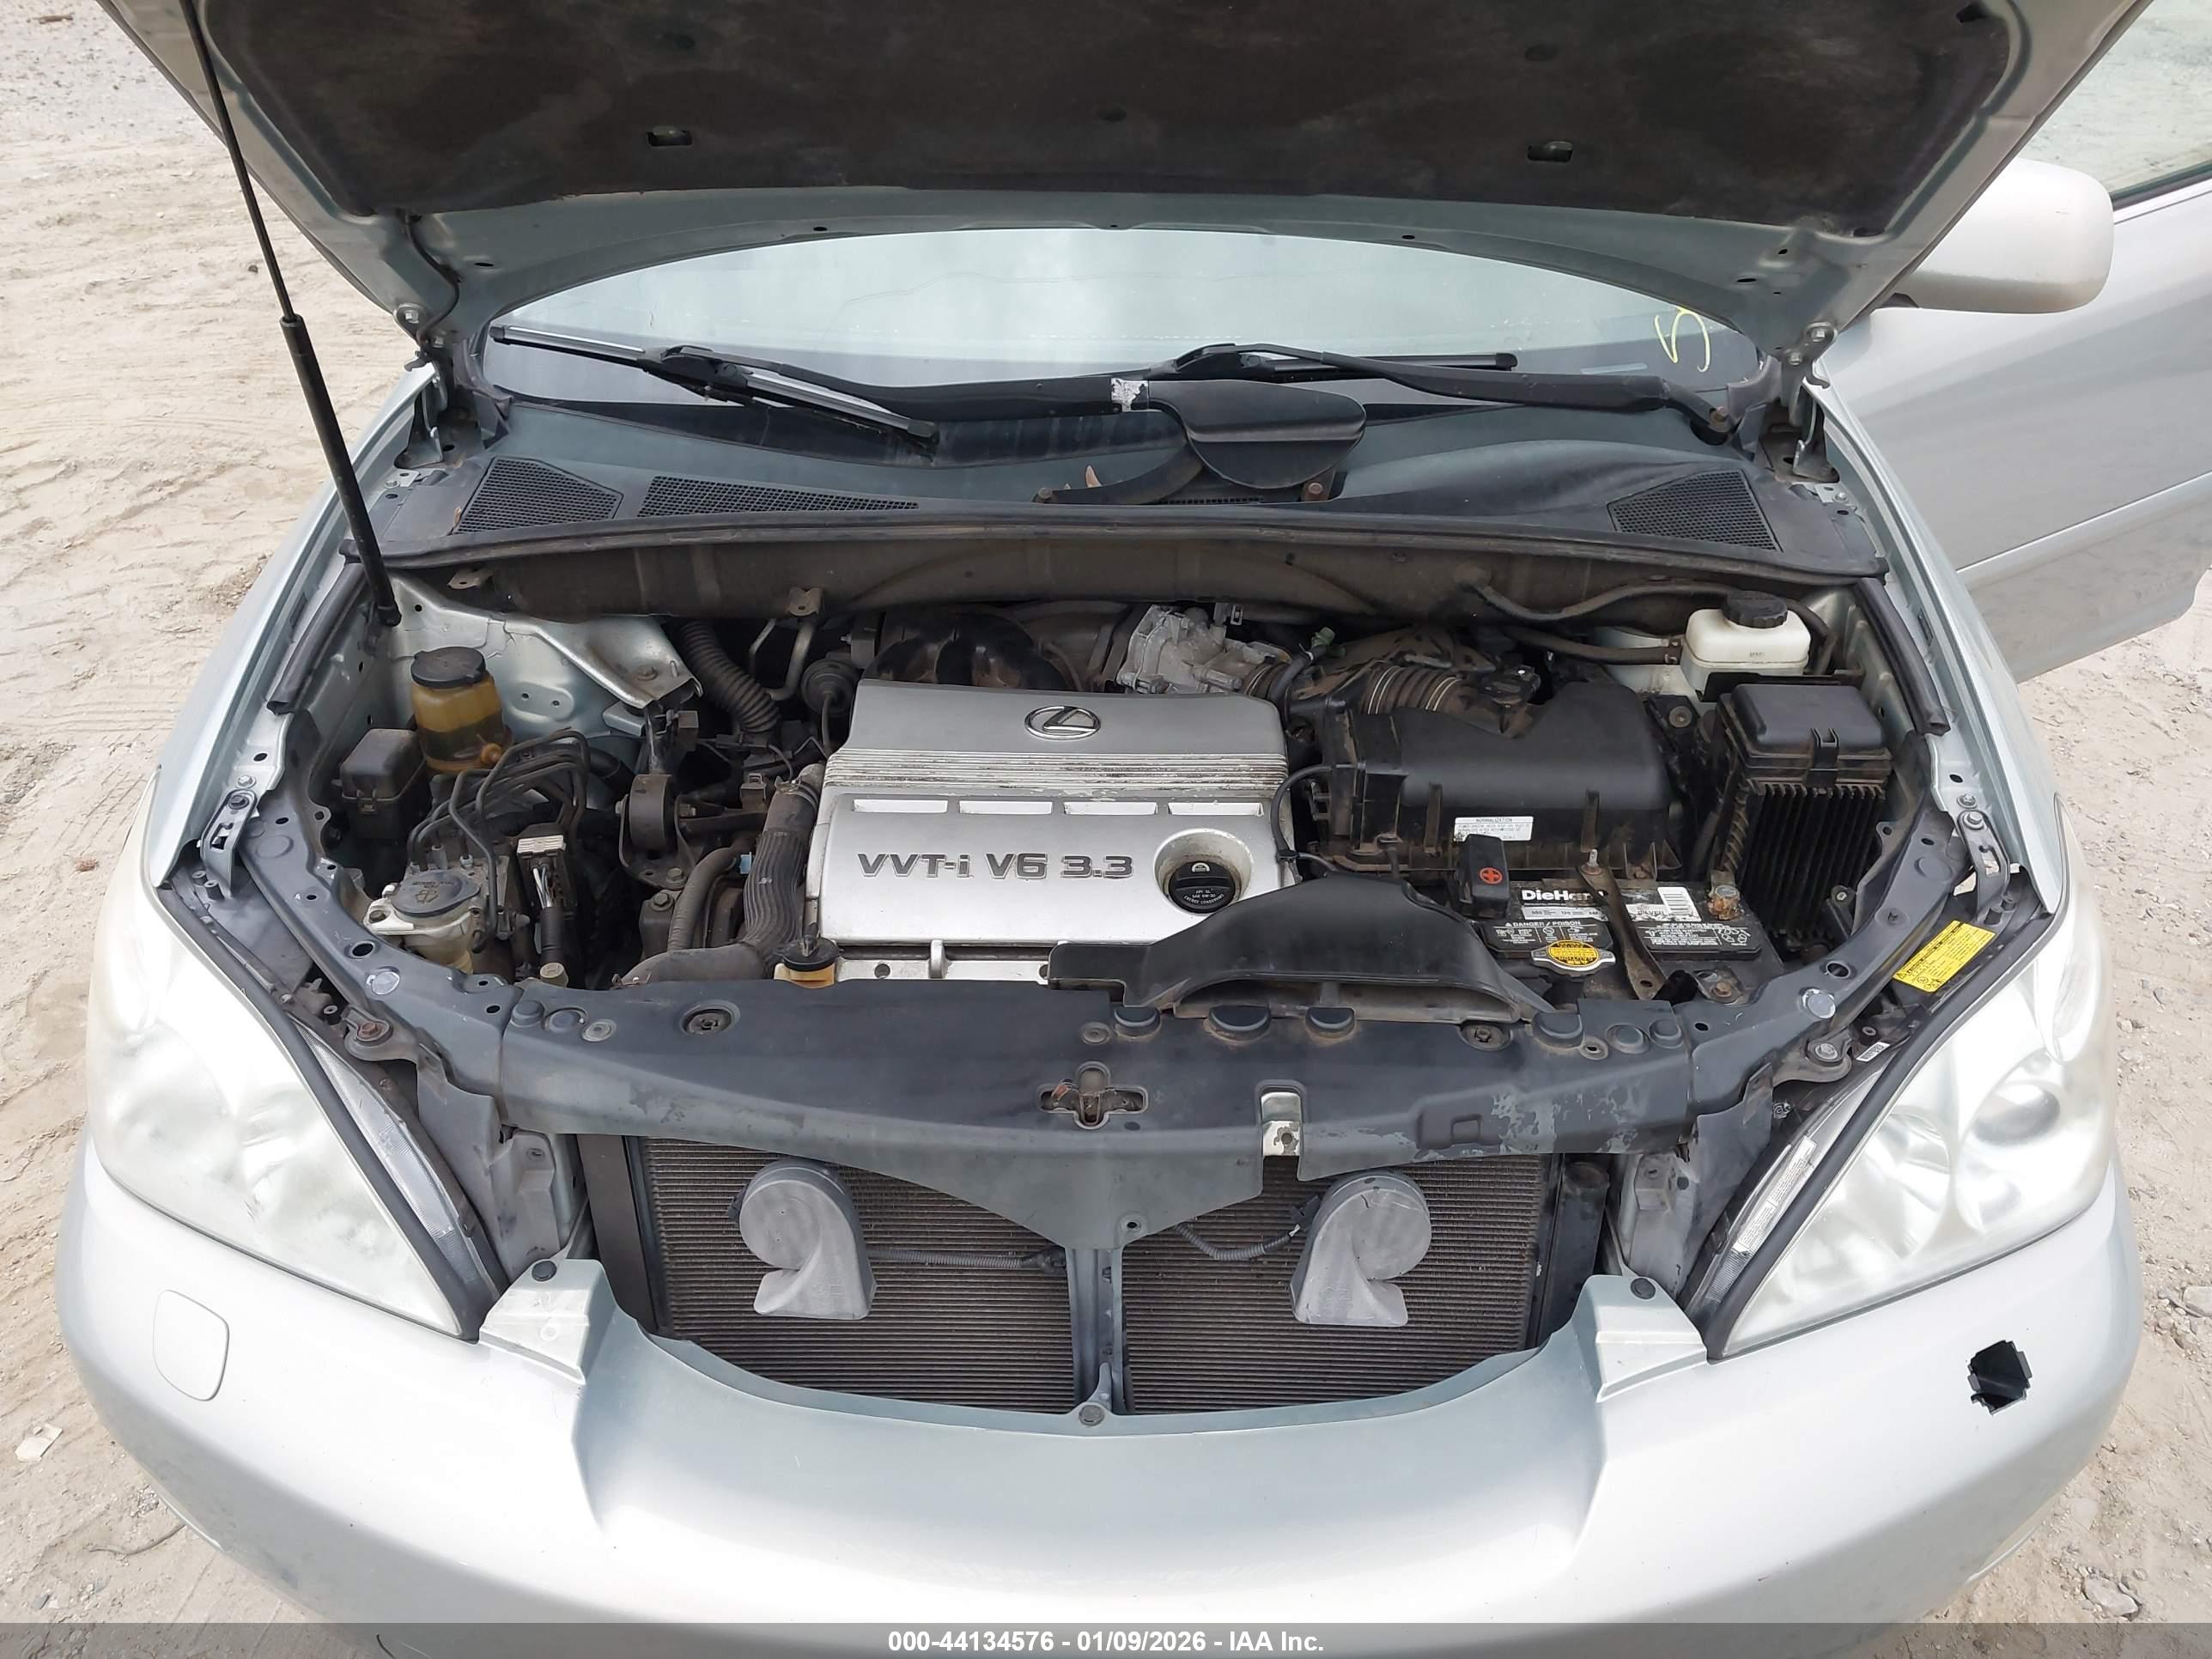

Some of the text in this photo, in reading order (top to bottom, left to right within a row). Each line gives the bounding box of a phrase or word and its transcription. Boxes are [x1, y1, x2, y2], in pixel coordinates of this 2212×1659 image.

[857, 854, 1133, 879] VVT-i V6 3.3
